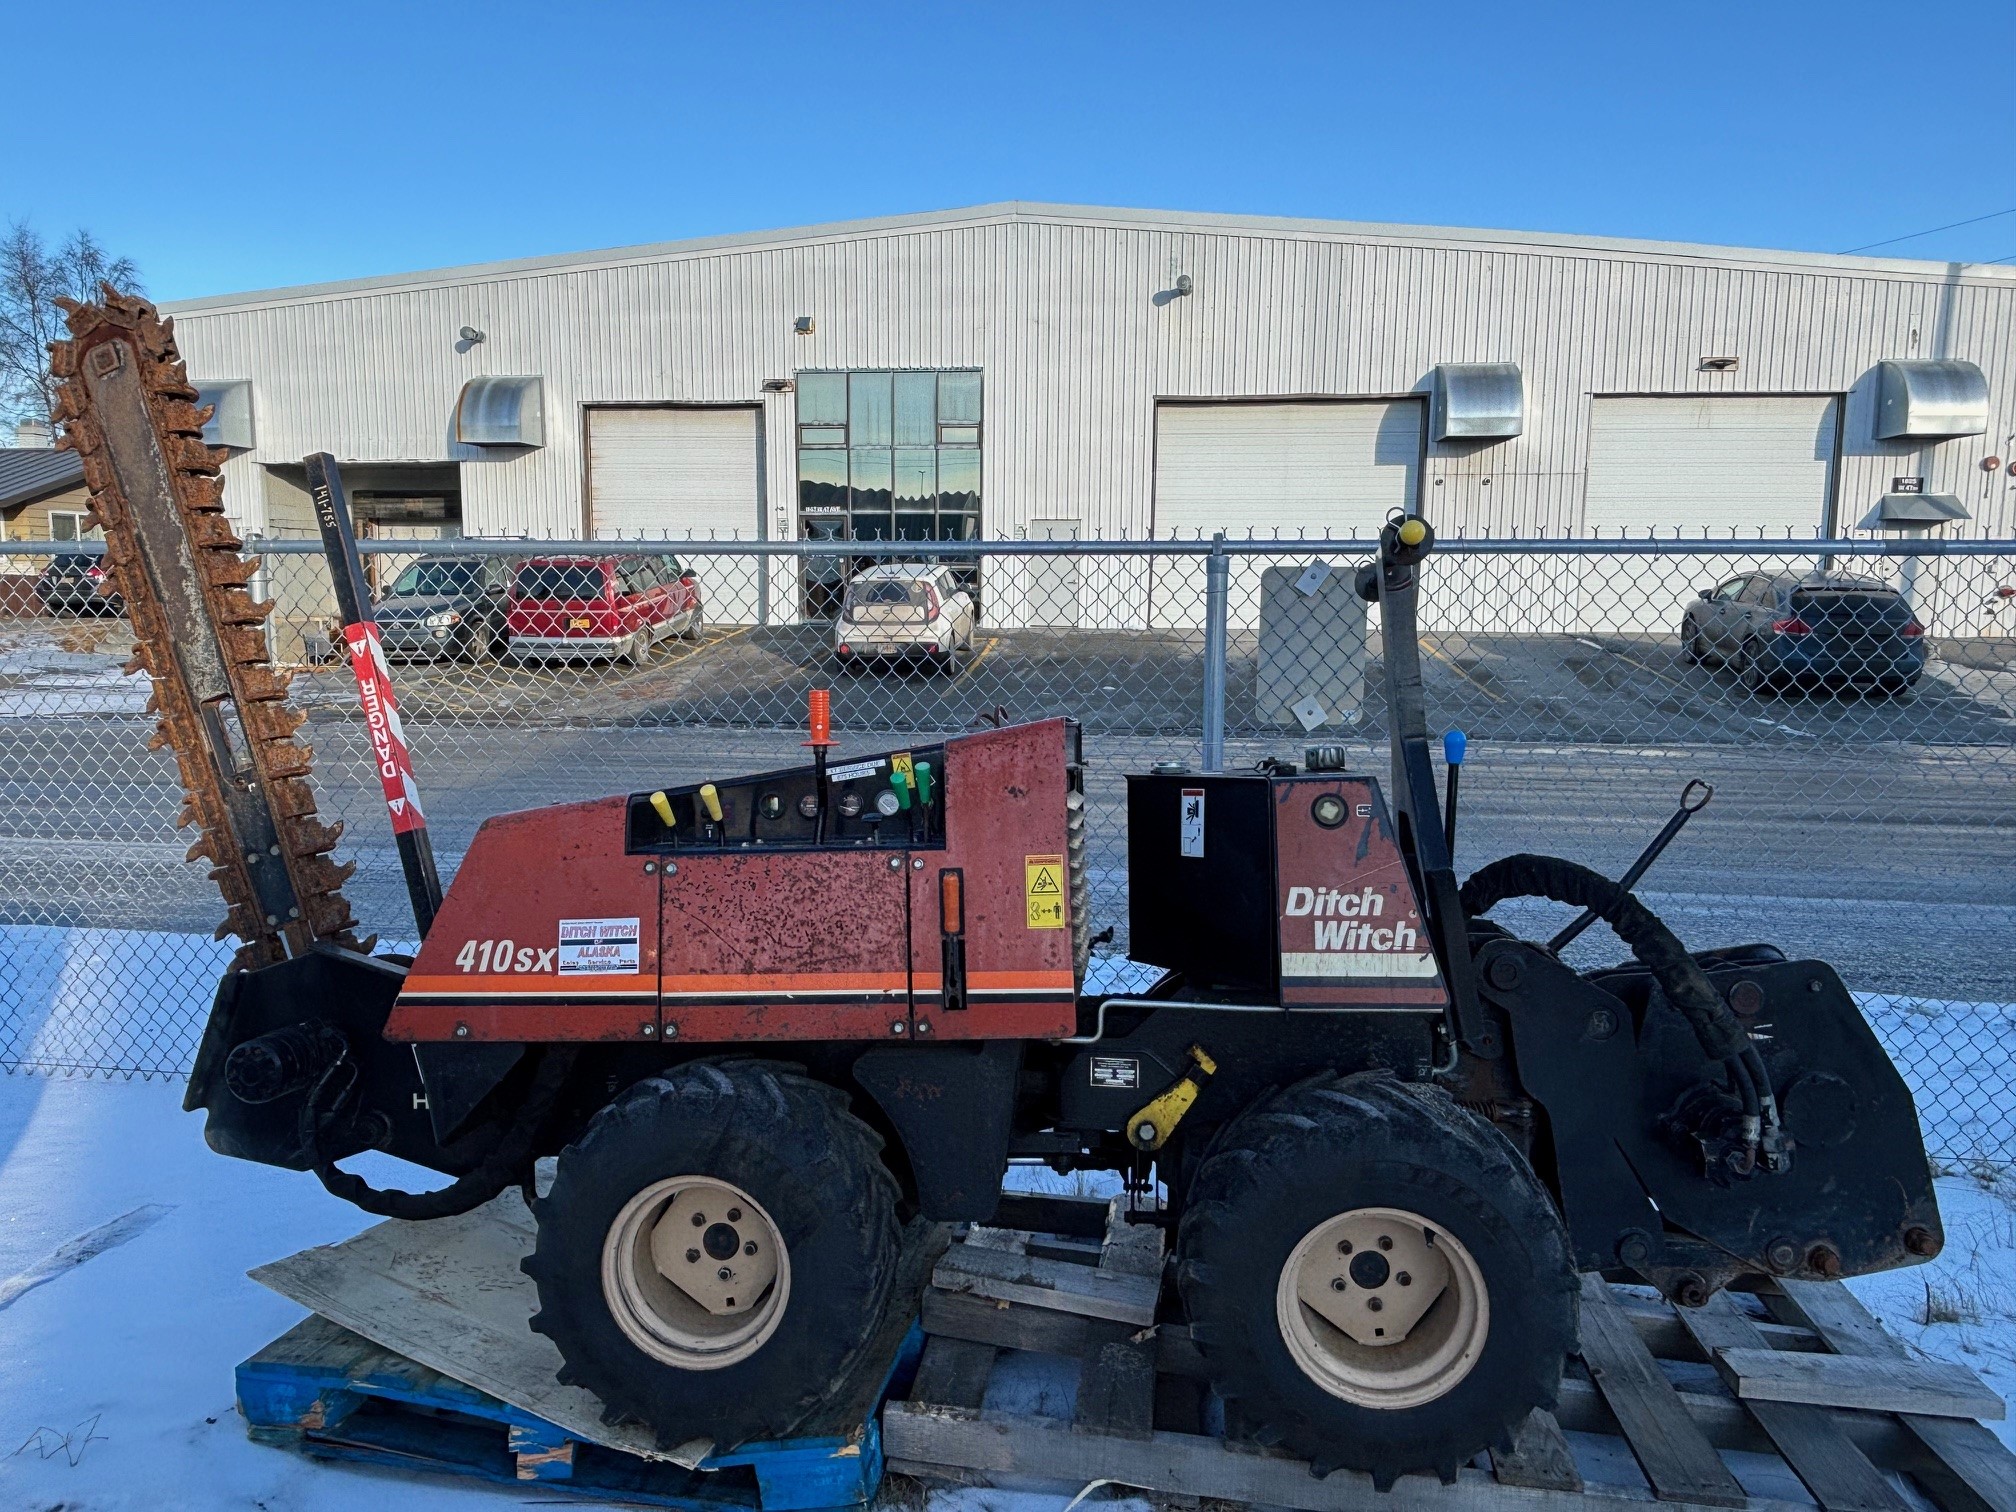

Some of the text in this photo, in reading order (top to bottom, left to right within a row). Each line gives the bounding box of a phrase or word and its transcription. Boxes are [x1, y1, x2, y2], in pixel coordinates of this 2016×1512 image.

[314, 485, 337, 528] 141-755
[361, 677, 397, 779] DANGER
[1285, 886, 1384, 917] Ditch
[561, 924, 638, 939] DITCH WITCH
[1314, 920, 1417, 951] Witch
[577, 945, 621, 958] ALASKA
